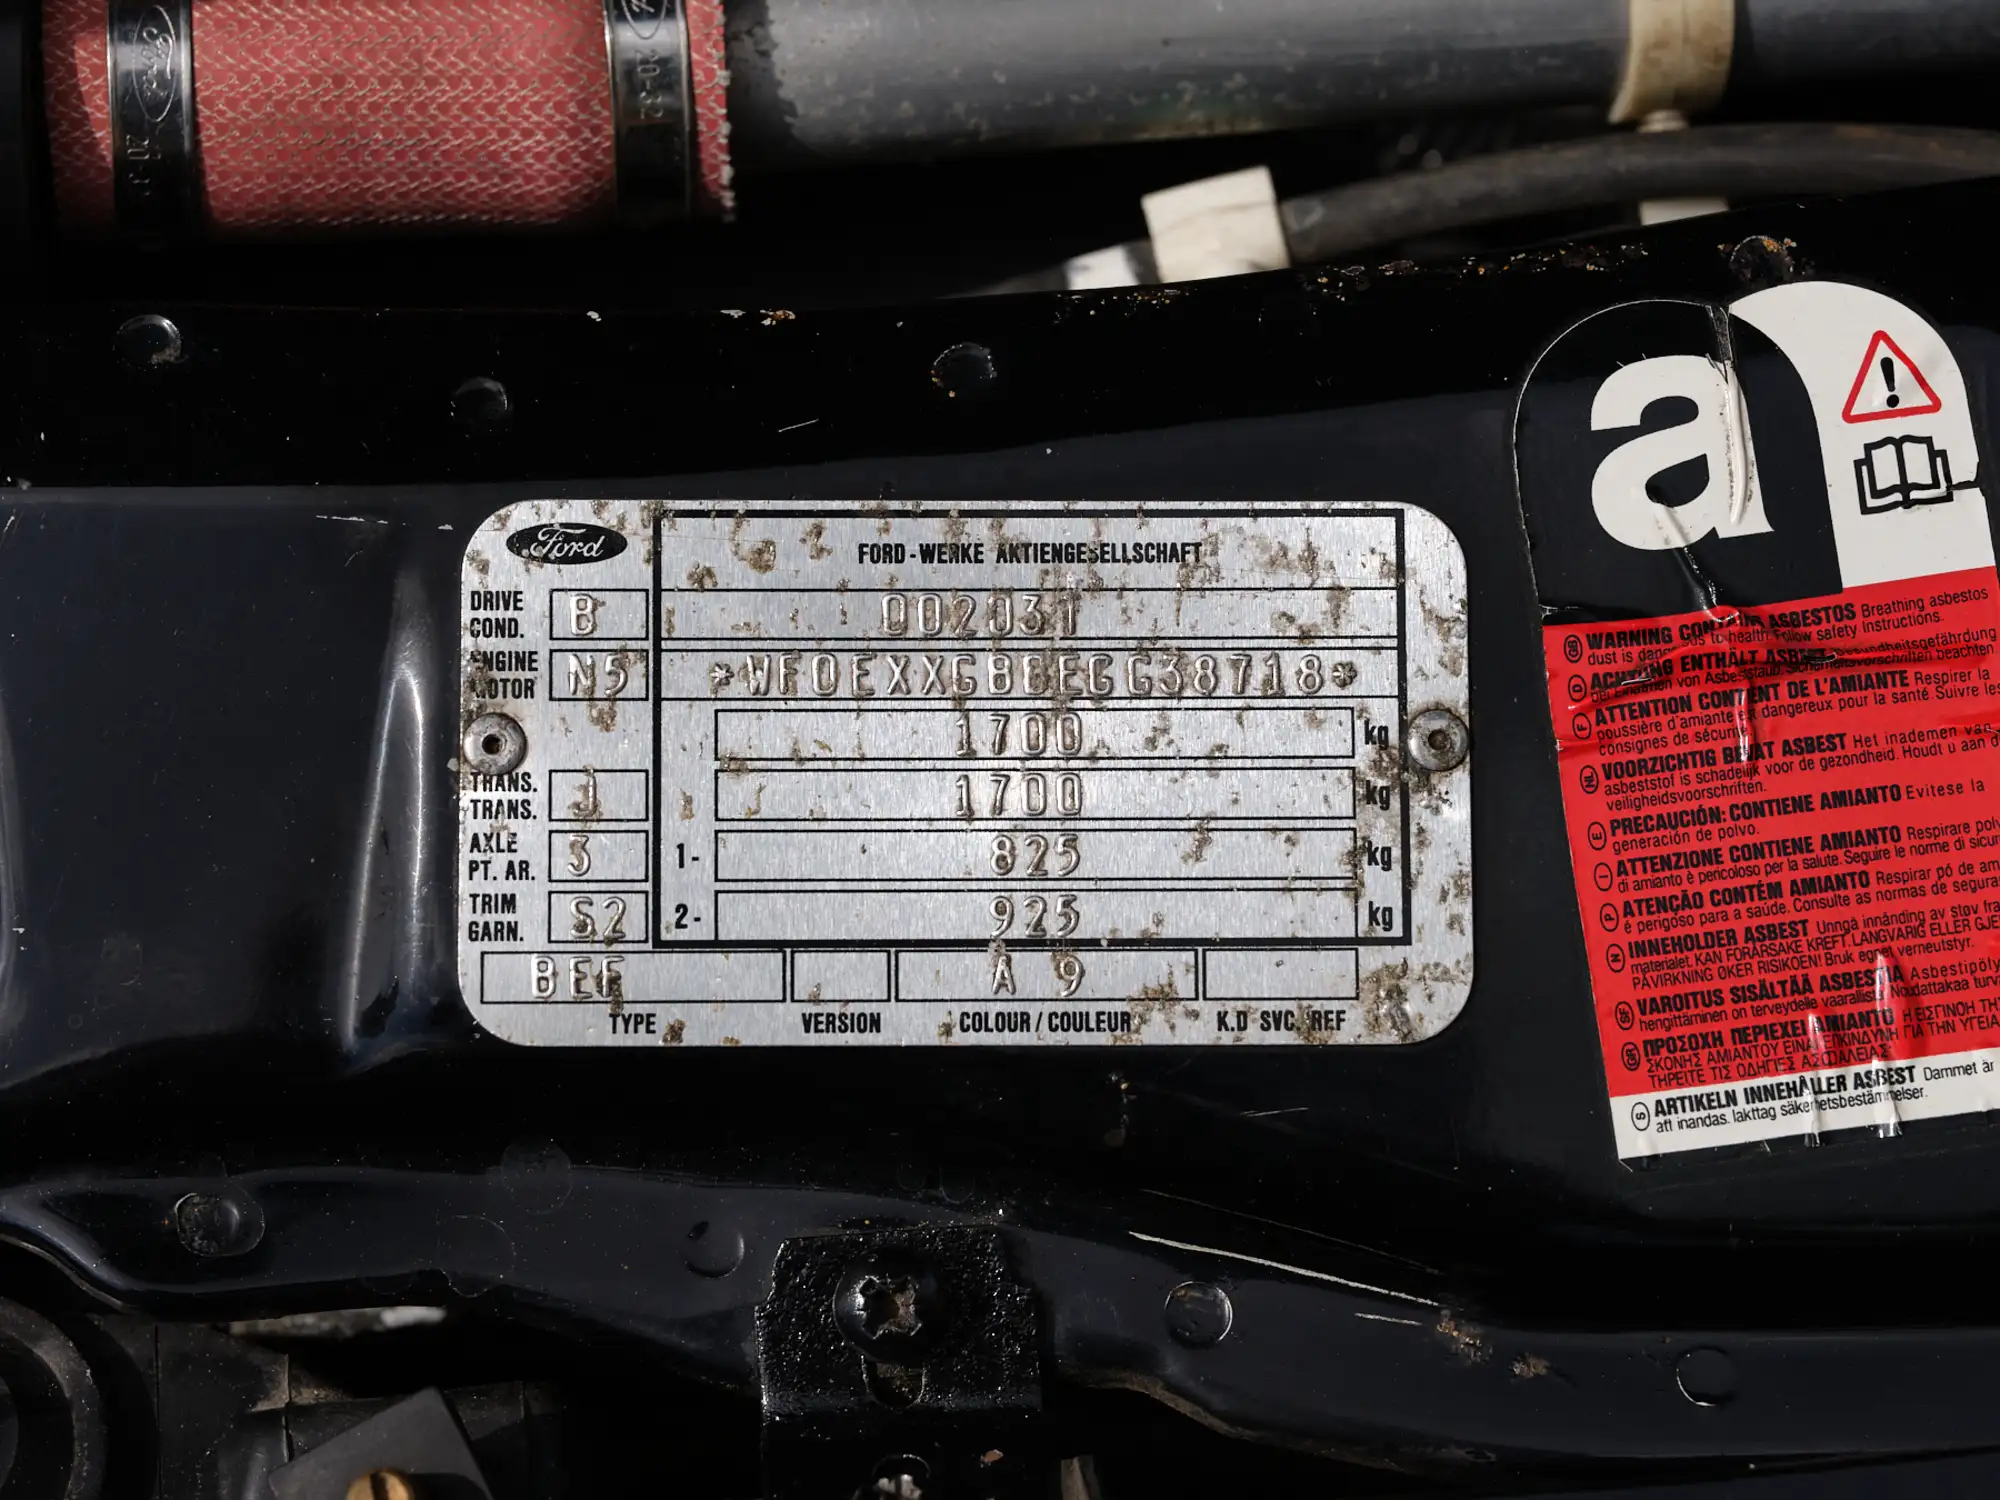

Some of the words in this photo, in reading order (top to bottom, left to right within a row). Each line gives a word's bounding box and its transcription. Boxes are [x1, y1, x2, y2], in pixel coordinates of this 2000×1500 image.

[1591, 355, 1774, 551] a
[529, 527, 606, 559] Ford
[996, 541, 1202, 564] AKTIENGESELLSCHAFT
[470, 590, 524, 611] DRIVE
[570, 592, 597, 636] B
[1586, 627, 1673, 650] WARNING
[1768, 603, 1857, 629] ASBESTOS
[1861, 596, 1925, 619] Breathing
[1930, 587, 1989, 608] asbestos
[470, 617, 525, 638] COND.
[1588, 651, 1618, 666] dust
[1622, 649, 1633, 664] is
[1816, 623, 1857, 641] safety
[470, 651, 538, 672] ENGINE
[568, 653, 629, 697] N5
[1677, 674, 1700, 688] von
[1681, 647, 1759, 673] ENTHÄLT
[1595, 695, 1692, 726] ATTENTION
[1787, 679, 1810, 699] DE
[1815, 670, 1910, 696] L'AMIANTE
[1914, 670, 1972, 688] Respirer
[1978, 667, 1990, 682] la
[1597, 719, 1662, 742] poussière
[1667, 710, 1734, 731] d'amiante
[1761, 700, 1833, 719] dangereux
[1838, 695, 1869, 712] pour
[1874, 692, 1885, 705] la
[1935, 684, 1979, 700] Suivre
[955, 711, 1083, 757] 1700
[1364, 719, 1389, 749] kg
[1599, 735, 1668, 757] consignes
[1673, 731, 1690, 746] de
[1601, 748, 1717, 781] VOORZICHTIG
[1782, 733, 1847, 758] ASBEST
[1853, 734, 1879, 749] Het
[1885, 726, 1957, 746] inademen
[1964, 722, 1991, 736] van
[470, 771, 538, 793] TRANS.
[1604, 772, 1675, 796] asbeststof
[1680, 771, 1691, 786] is
[1765, 762, 1794, 776] voor
[1799, 758, 1815, 772] de
[1820, 748, 1900, 772] gezondheid.
[1903, 743, 1943, 760] Houdt
[1961, 737, 1985, 752] aan
[470, 799, 537, 820] TRANS.
[955, 772, 1083, 817] 1700
[1365, 780, 1391, 810] kg
[1606, 780, 1767, 812] veiligheidsvoorschriften.
[1610, 804, 1727, 837] PRECAUCIÓN:
[1729, 794, 1815, 822] CONTIENE
[1820, 784, 1902, 810] AMIANTO
[1906, 783, 1964, 800] Evitese
[1971, 777, 1985, 792] la
[470, 832, 518, 853] AXLE
[568, 834, 591, 877] 3
[990, 834, 1081, 877] 825
[1367, 840, 1392, 871] kg
[1613, 832, 1690, 856] generación
[1696, 828, 1712, 843] de
[1718, 824, 1760, 844] polvo.
[1616, 847, 1725, 878] ATTENZIONE
[1729, 836, 1815, 864] CONTIENE
[1820, 825, 1901, 852] AMIANTO
[1907, 821, 1971, 842] Respirare
[469, 860, 498, 881] PT.
[505, 860, 536, 881] AR.
[1618, 878, 1629, 893] di
[1633, 873, 1683, 891] amianto
[1698, 864, 1761, 885] pericoloso
[1764, 862, 1784, 877] per
[1787, 858, 1799, 873] la
[1802, 853, 1843, 871] salute.
[1844, 848, 1891, 866] Seguire
[1895, 845, 1906, 859] le
[1909, 841, 1949, 857] norme
[1954, 836, 1965, 851] di
[469, 893, 517, 914] TRIM
[1623, 888, 1705, 918] ATENÇÃO
[1709, 880, 1783, 907] CONTÉM
[1790, 870, 1870, 897] AMIANTO
[1876, 867, 1931, 885] Respirar
[1936, 863, 1954, 881] pó
[1958, 860, 1975, 876] de
[1637, 913, 1695, 934] perigoso
[1700, 908, 1729, 926] para
[1746, 902, 1790, 919] saúde.
[1793, 893, 1851, 913] Consulte
[1855, 892, 1871, 905] as
[1876, 884, 1926, 902] normas
[1931, 880, 1948, 896] de
[468, 921, 524, 942] GARN.
[569, 896, 627, 940] S2
[989, 895, 1080, 938] 925
[1368, 901, 1393, 932] kg
[1628, 928, 1738, 959] INNEHOLDER
[1744, 919, 1809, 945] ASBEST
[1930, 907, 1946, 921] av
[1695, 950, 1723, 966] KAN
[1852, 922, 1927, 948] LANGVARIG
[1930, 918, 1971, 938] ELLER
[1757, 955, 1822, 976] RISIKOEN!
[1825, 951, 1854, 967] Bruk
[1858, 946, 1895, 965] egnet
[1899, 936, 1975, 957] verneutstyr.
[531, 955, 625, 1000] BEF
[991, 955, 1018, 996] A
[1057, 955, 1086, 997] 9
[1636, 988, 1724, 1016] VAROITUS
[1729, 973, 1814, 1004] SISÄLTÄÄ
[608, 1012, 657, 1034] TYPE
[802, 1012, 881, 1034] VERSION
[1217, 1010, 1248, 1031] K.D
[1310, 1010, 1346, 1031] REF
[1732, 1007, 1747, 1021] on
[1654, 1088, 1738, 1117] ARTIKELN
[1853, 1066, 1916, 1091] ASBEST
[1923, 1062, 1978, 1081] Dammet
[1982, 1060, 1994, 1073] är
[1656, 1118, 1672, 1134] att
[1677, 1113, 1730, 1130] inandas.
